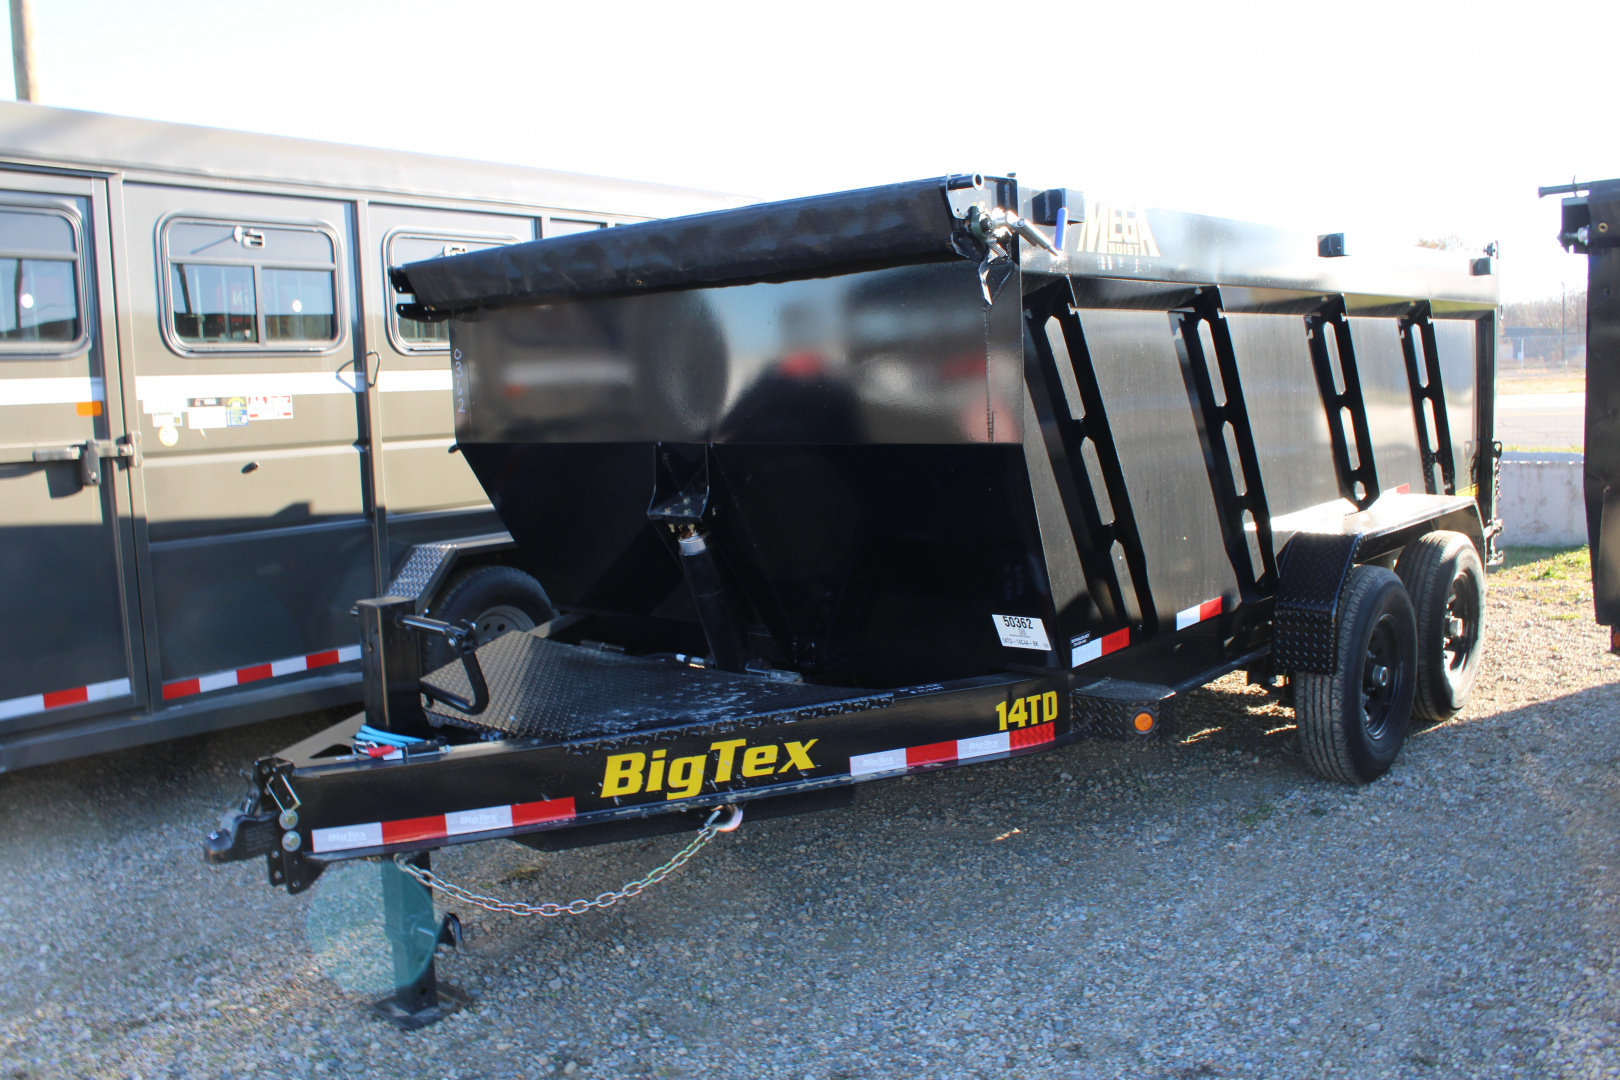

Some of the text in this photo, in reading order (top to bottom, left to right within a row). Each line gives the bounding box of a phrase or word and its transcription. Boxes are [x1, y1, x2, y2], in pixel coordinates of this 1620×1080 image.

[1077, 199, 1161, 257] MEGA
[1107, 242, 1140, 256] HOIST
[1002, 616, 1034, 630] 50362
[995, 690, 1058, 731] 14TD
[600, 738, 819, 800] BigTex
